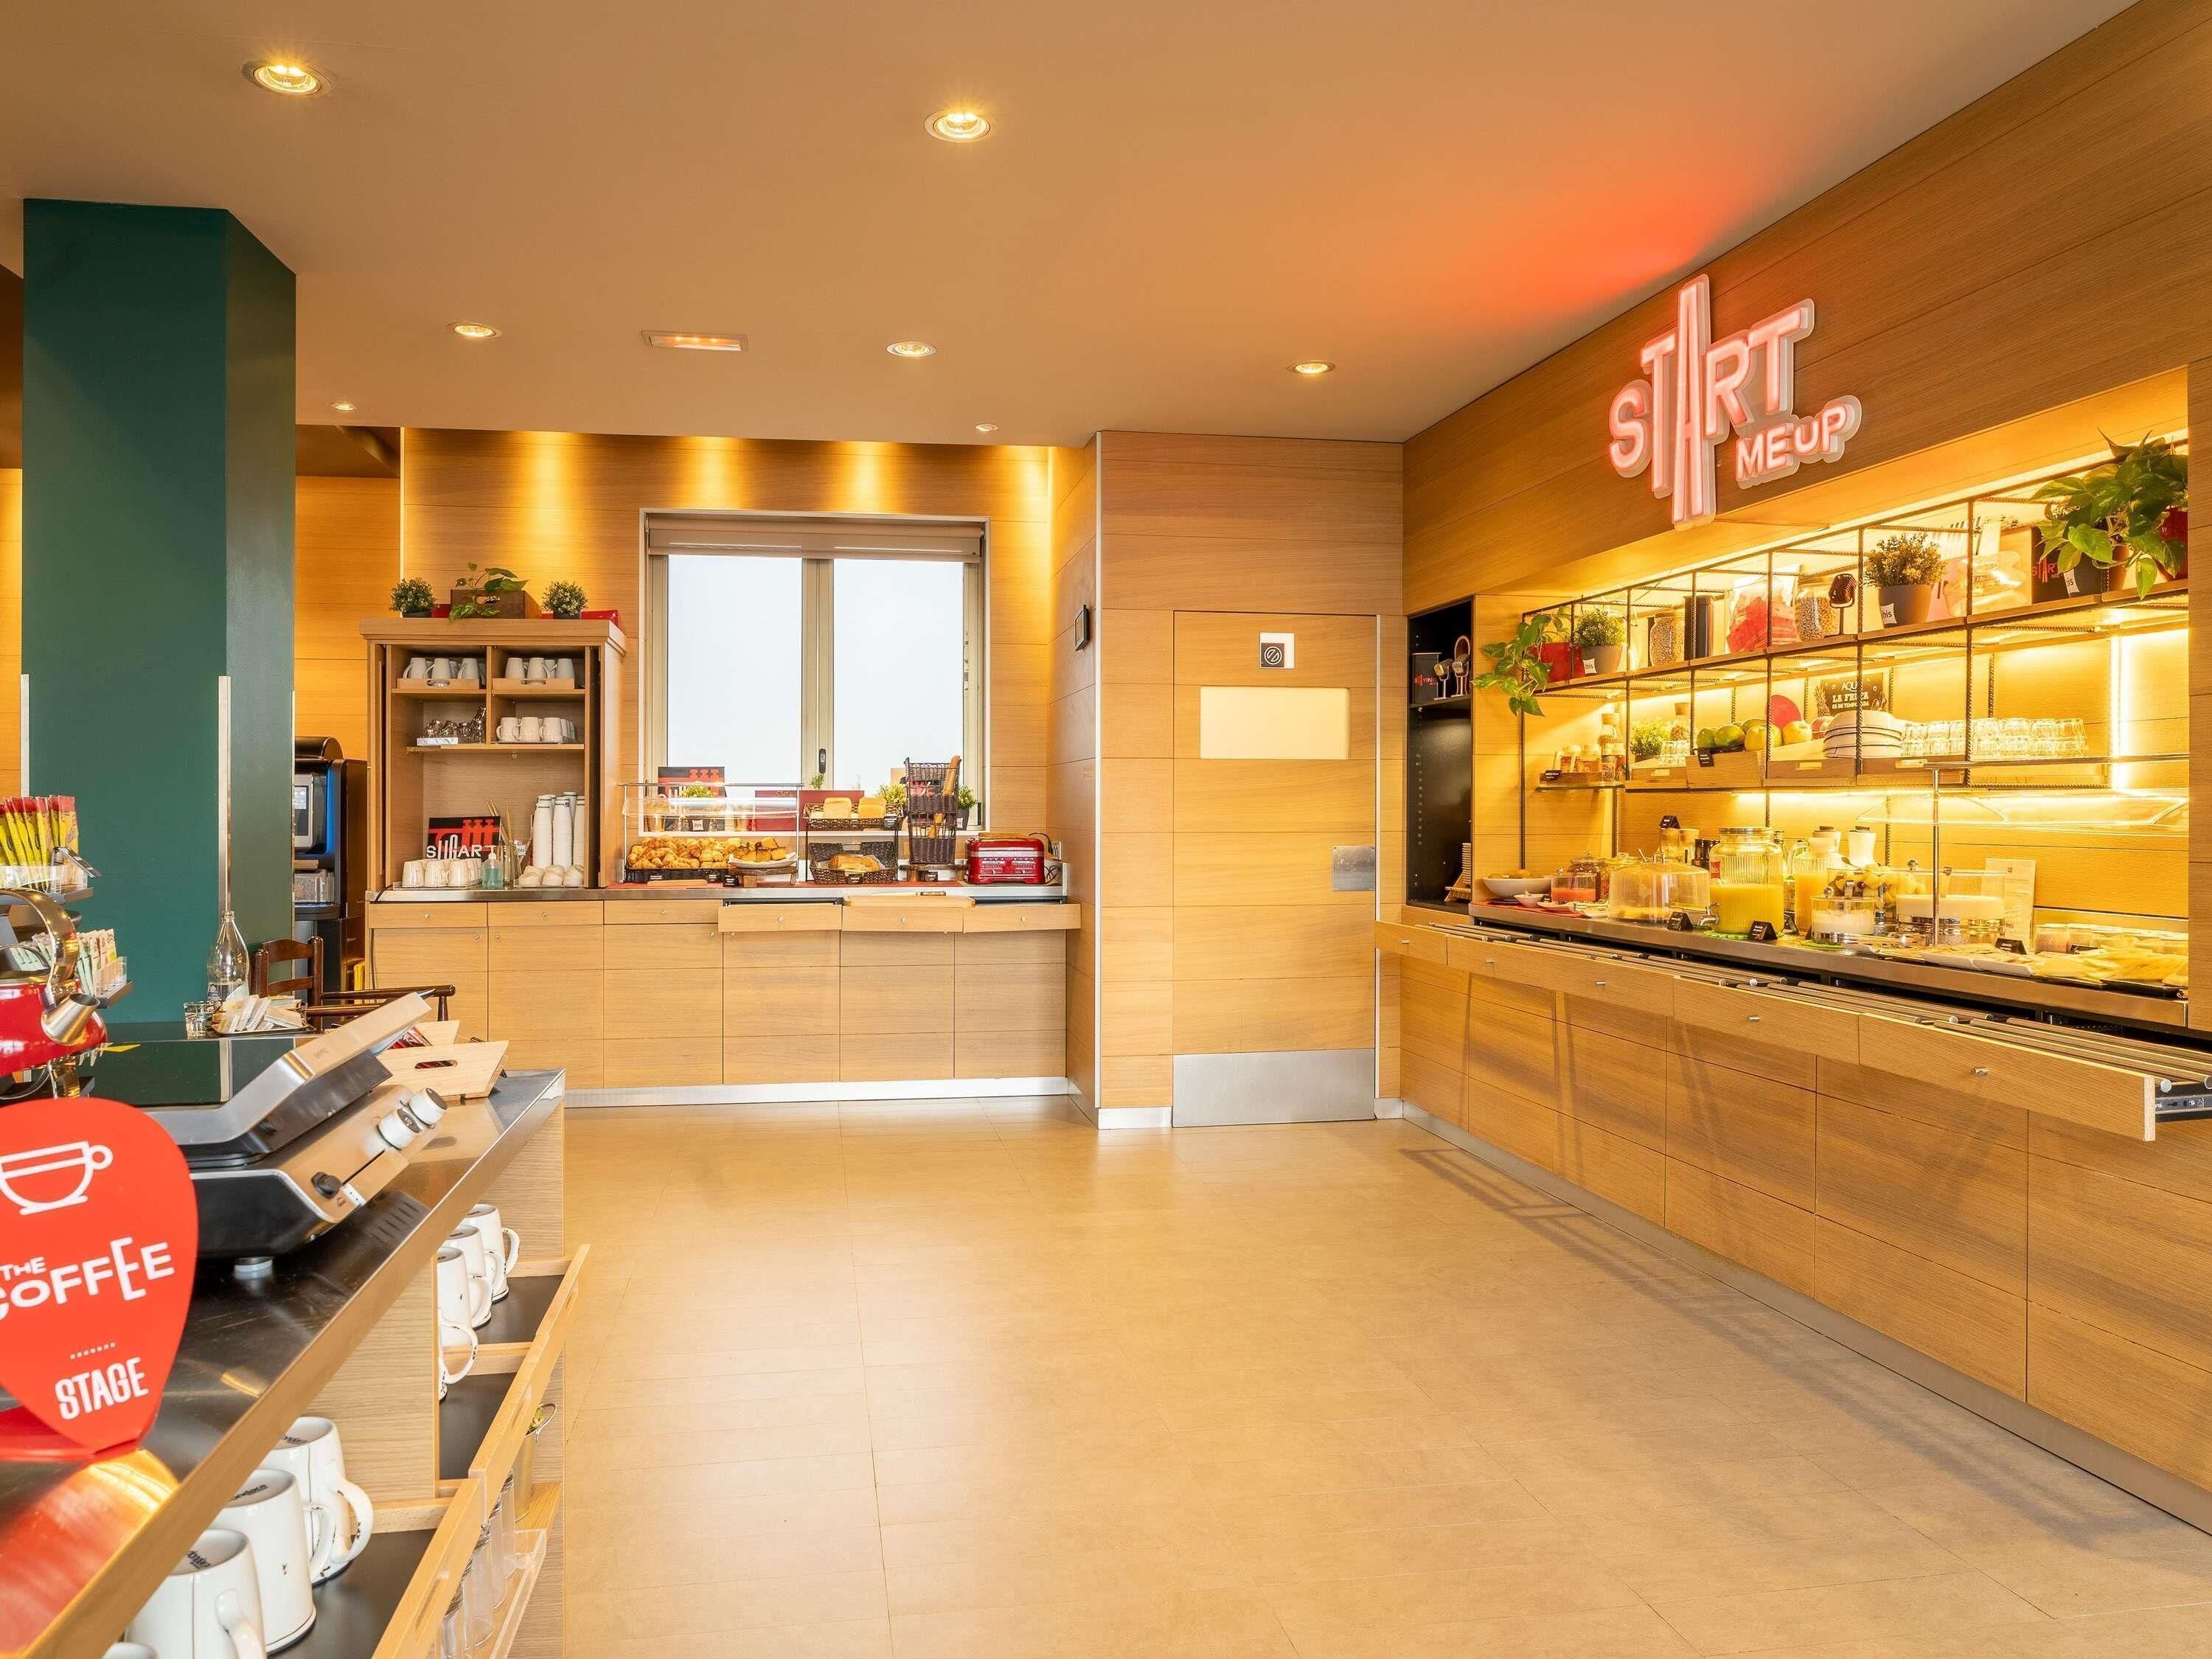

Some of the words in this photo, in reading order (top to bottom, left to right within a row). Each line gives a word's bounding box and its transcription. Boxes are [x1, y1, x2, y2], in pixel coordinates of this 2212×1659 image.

[1609, 279, 1804, 524] START
[1736, 422, 1790, 483] ME
[1793, 403, 1849, 456] UP
[2032, 557, 2057, 583] STAR
[1832, 695, 1842, 703] LA
[1844, 692, 1869, 701] FRA
[1841, 681, 1857, 692] AQU
[0, 1256, 47, 1281] THE
[0, 1236, 175, 1321] OFFEE
[54, 1356, 150, 1421] STAGE
